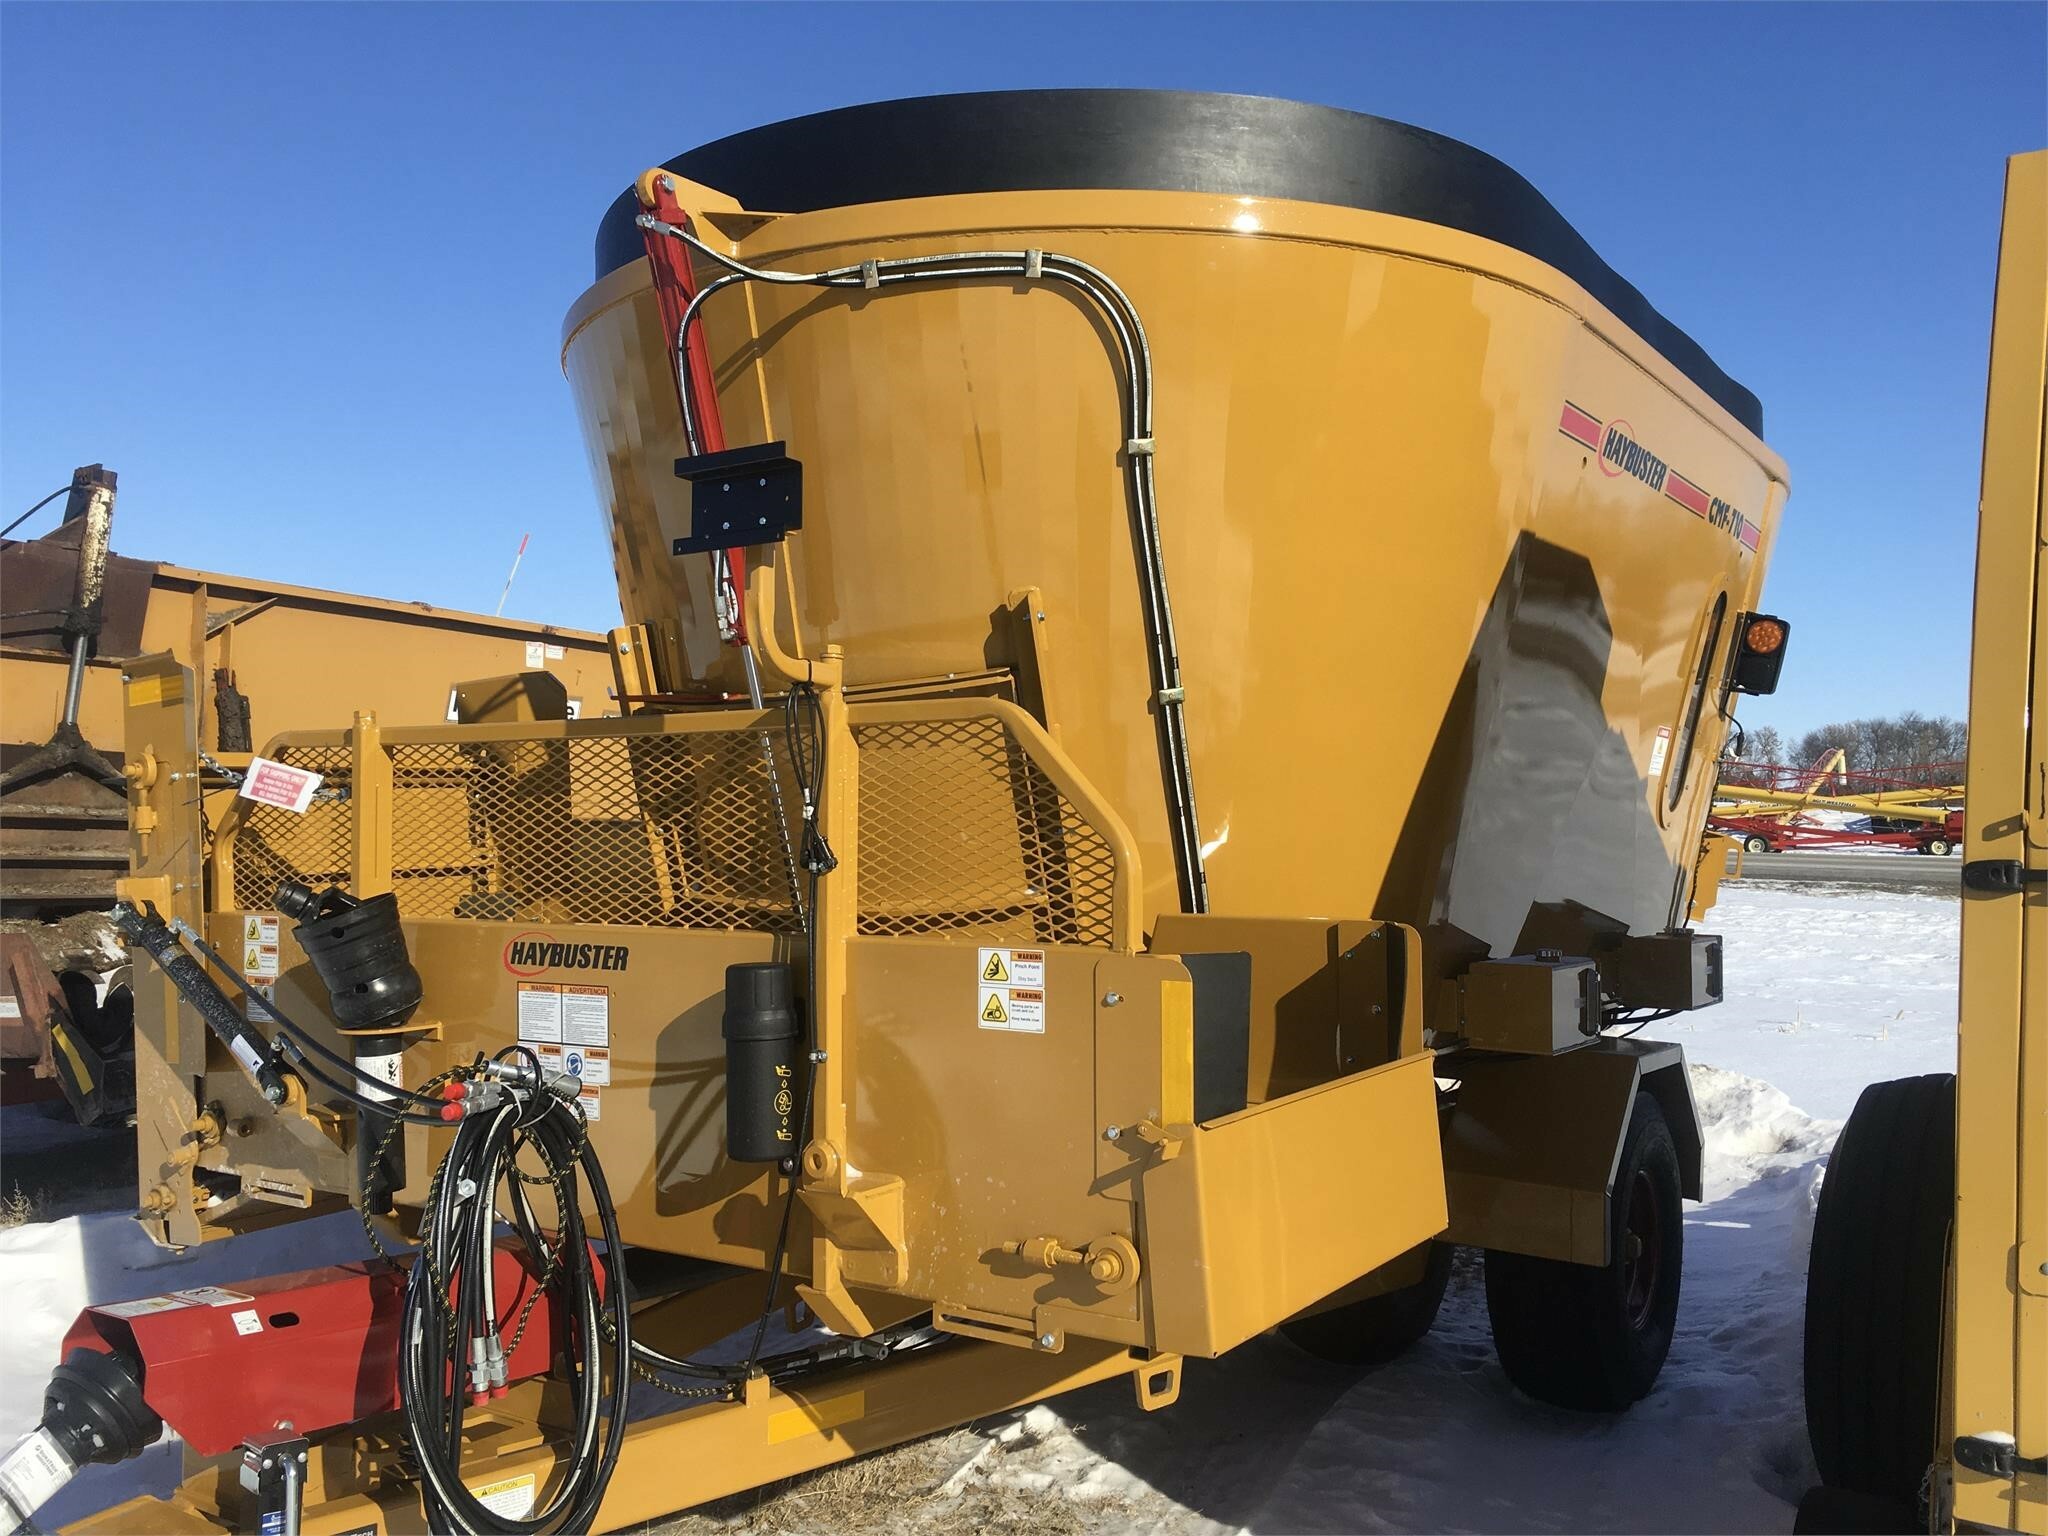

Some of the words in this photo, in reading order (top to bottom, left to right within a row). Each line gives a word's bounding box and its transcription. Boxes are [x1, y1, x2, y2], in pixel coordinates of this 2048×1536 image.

[1602, 427, 1668, 492] HAYBUSTER
[1708, 497, 1744, 540] CMF-710
[510, 941, 629, 971] HAYBUSTER
[1017, 953, 1042, 961] WARNING
[530, 984, 555, 993] WARNING
[568, 987, 607, 995] ADVERTENCIA
[1016, 991, 1042, 1000] WARNING
[488, 1481, 518, 1494] CAUTION
